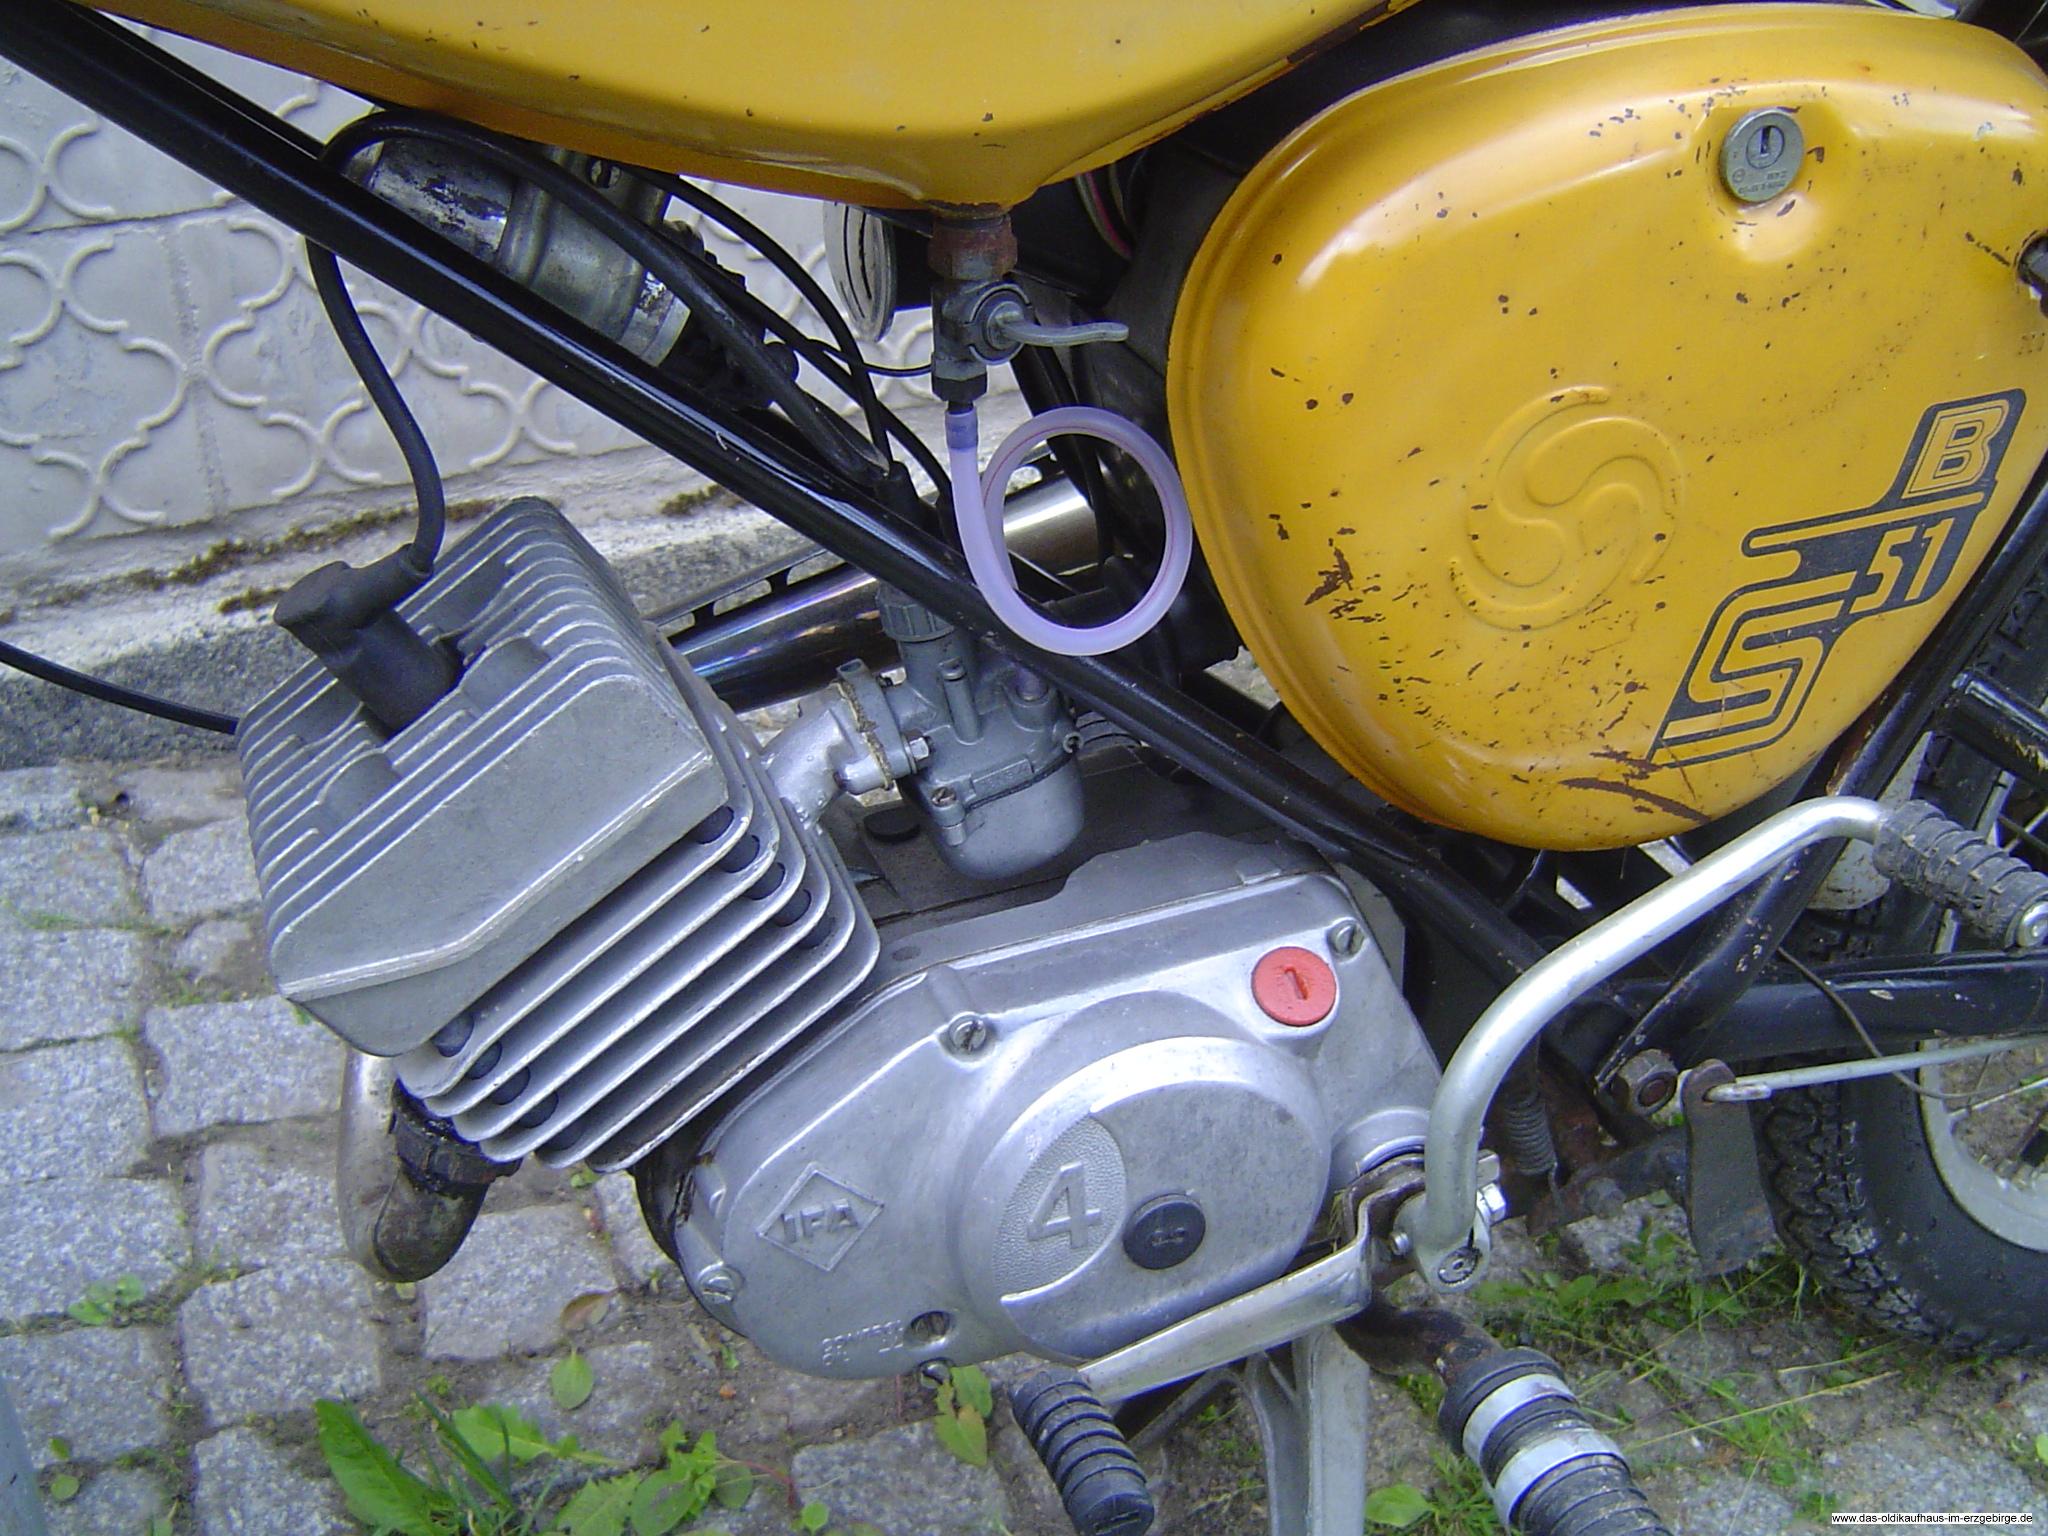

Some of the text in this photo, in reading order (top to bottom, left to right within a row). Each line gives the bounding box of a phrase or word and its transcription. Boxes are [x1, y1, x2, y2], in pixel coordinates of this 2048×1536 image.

[1901, 399, 2010, 499] B
[781, 1199, 859, 1243] IFA
[1026, 1161, 1101, 1250] 4
